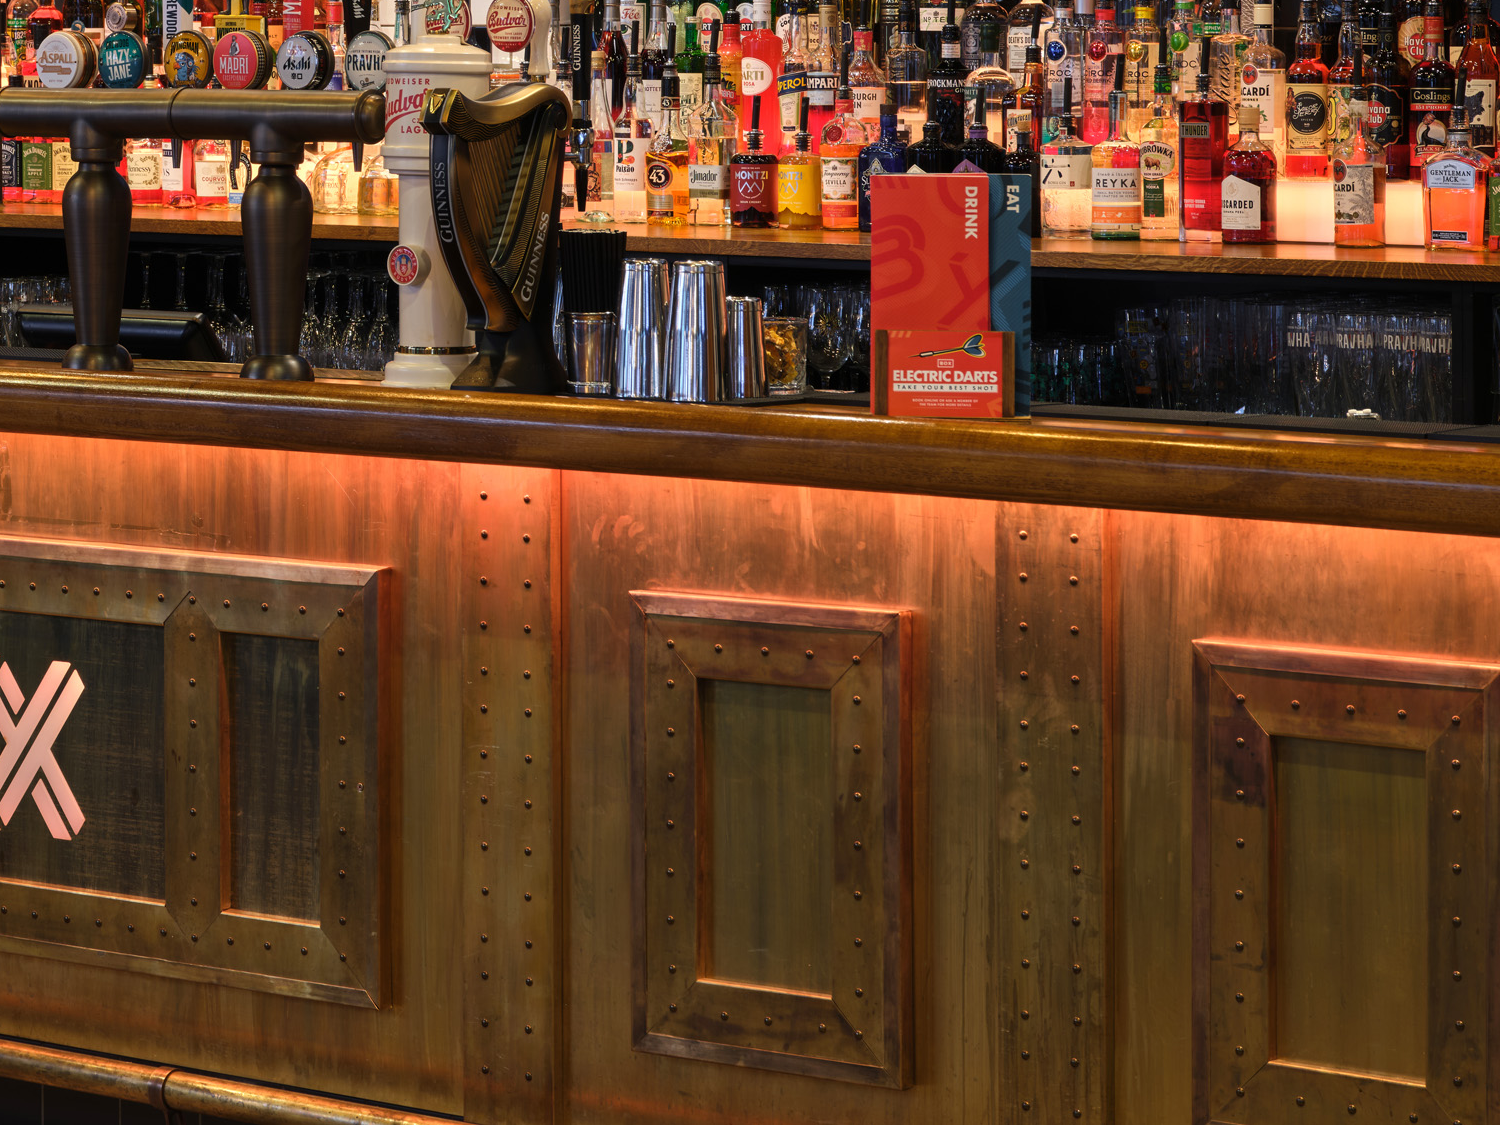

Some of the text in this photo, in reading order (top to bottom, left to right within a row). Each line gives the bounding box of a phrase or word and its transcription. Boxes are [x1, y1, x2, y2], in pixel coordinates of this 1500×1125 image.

[488, 11, 527, 29] Budvar
[572, 24, 581, 71] GUINNESS
[1404, 37, 1424, 47] Hava
[170, 41, 199, 57] WINGMAN
[1410, 47, 1424, 56] Clu
[106, 49, 130, 66] HAZY
[282, 57, 311, 71] Asahi
[108, 65, 132, 81] JANE
[386, 77, 430, 85] UDWEISER
[806, 77, 838, 89] MPARI
[927, 79, 966, 89] BROCKMANS
[662, 99, 670, 107] 43
[852, 93, 877, 101] BURGH
[1414, 91, 1450, 104] Goslings
[385, 88, 429, 119] udva
[1368, 105, 1390, 114] vana
[400, 125, 430, 134] LAGE
[1181, 124, 1208, 136] THUNDER
[649, 169, 666, 183] 43
[690, 169, 718, 183] Jimador
[734, 171, 768, 179] MONTZI
[1430, 169, 1472, 177] GENTLEMAN
[1096, 179, 1136, 187] REYKA
[1334, 182, 1354, 193] CARDÍ
[432, 161, 454, 243] GUINNESS
[1006, 185, 1020, 213] EAT
[1222, 199, 1254, 209] SCARDED
[964, 185, 978, 240] DRINK
[520, 211, 550, 303] GUINNESS
[892, 369, 998, 383] ELECTRIC DARTS
